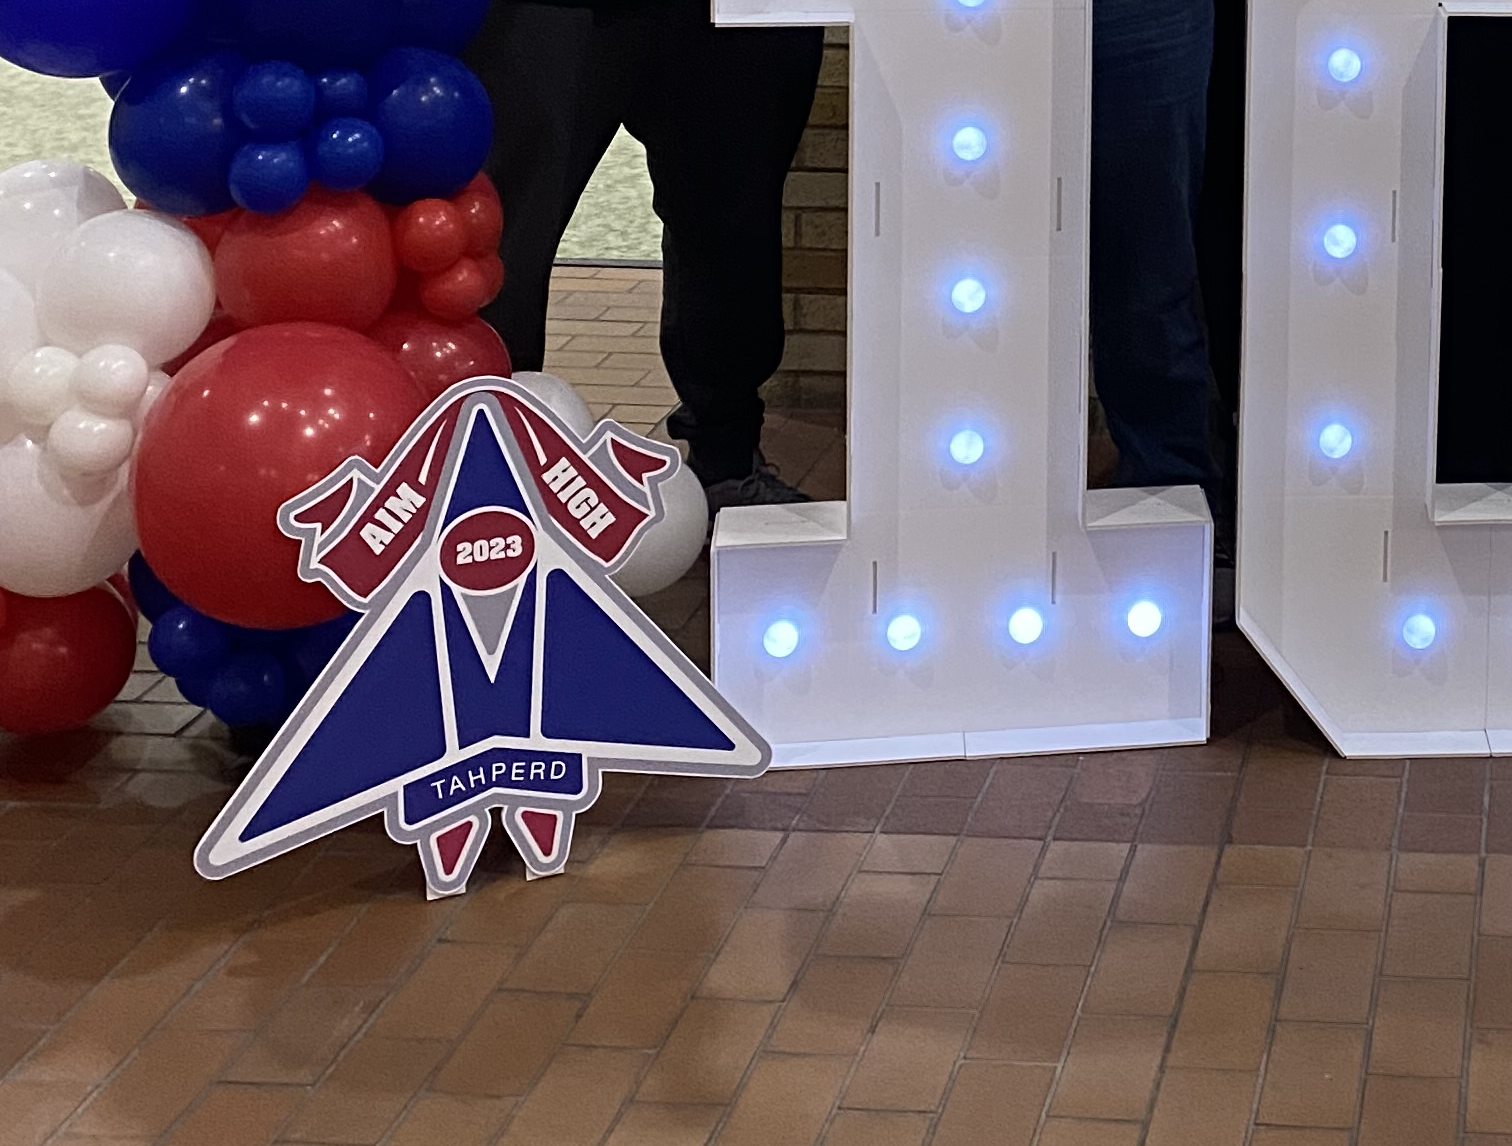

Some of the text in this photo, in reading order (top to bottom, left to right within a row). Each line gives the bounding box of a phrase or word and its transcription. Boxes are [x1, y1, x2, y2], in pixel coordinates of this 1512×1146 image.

[359, 456, 617, 555] AIM HIGH
[456, 534, 523, 566] 2023
[431, 760, 568, 800] TAHPERD
